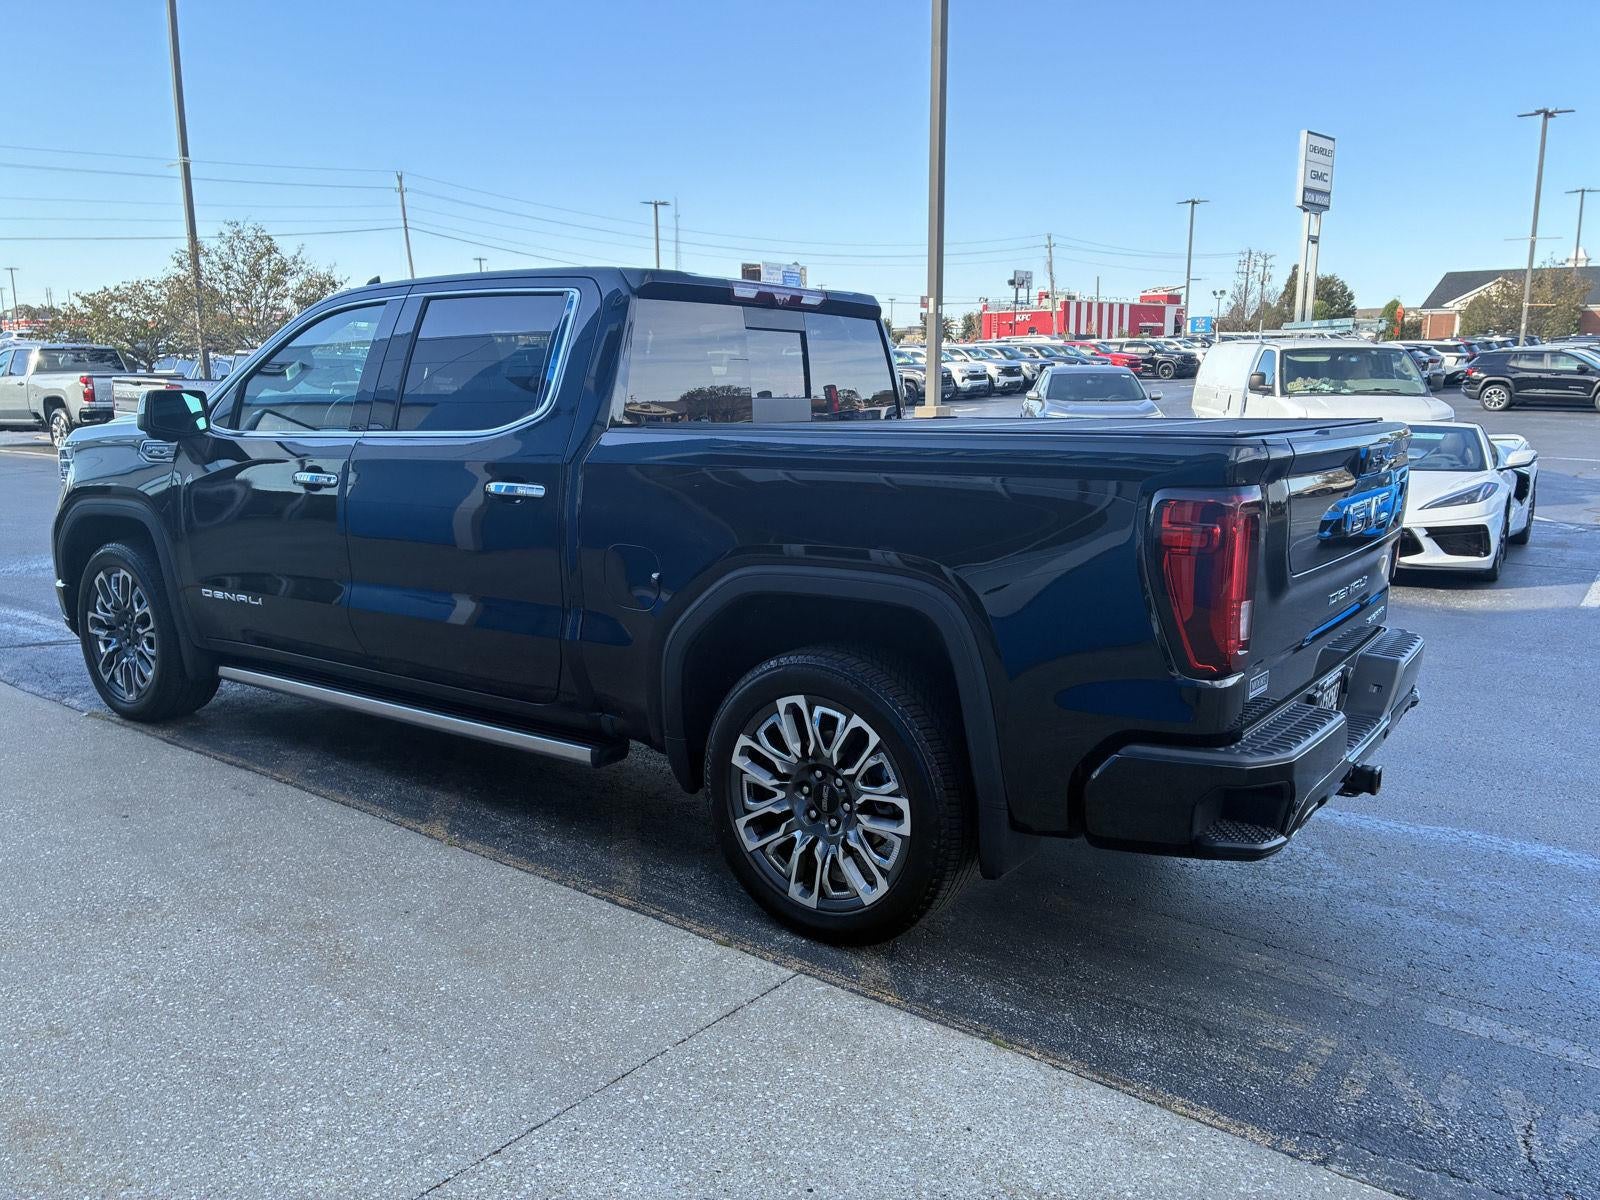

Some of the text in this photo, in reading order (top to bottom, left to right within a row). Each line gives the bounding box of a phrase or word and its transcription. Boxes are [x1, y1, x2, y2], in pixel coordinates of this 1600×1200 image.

[1309, 144, 1333, 157] CHEVROLET
[1310, 169, 1329, 182] GMC
[1015, 313, 1032, 322] KFC
[201, 588, 263, 606] DENALI
